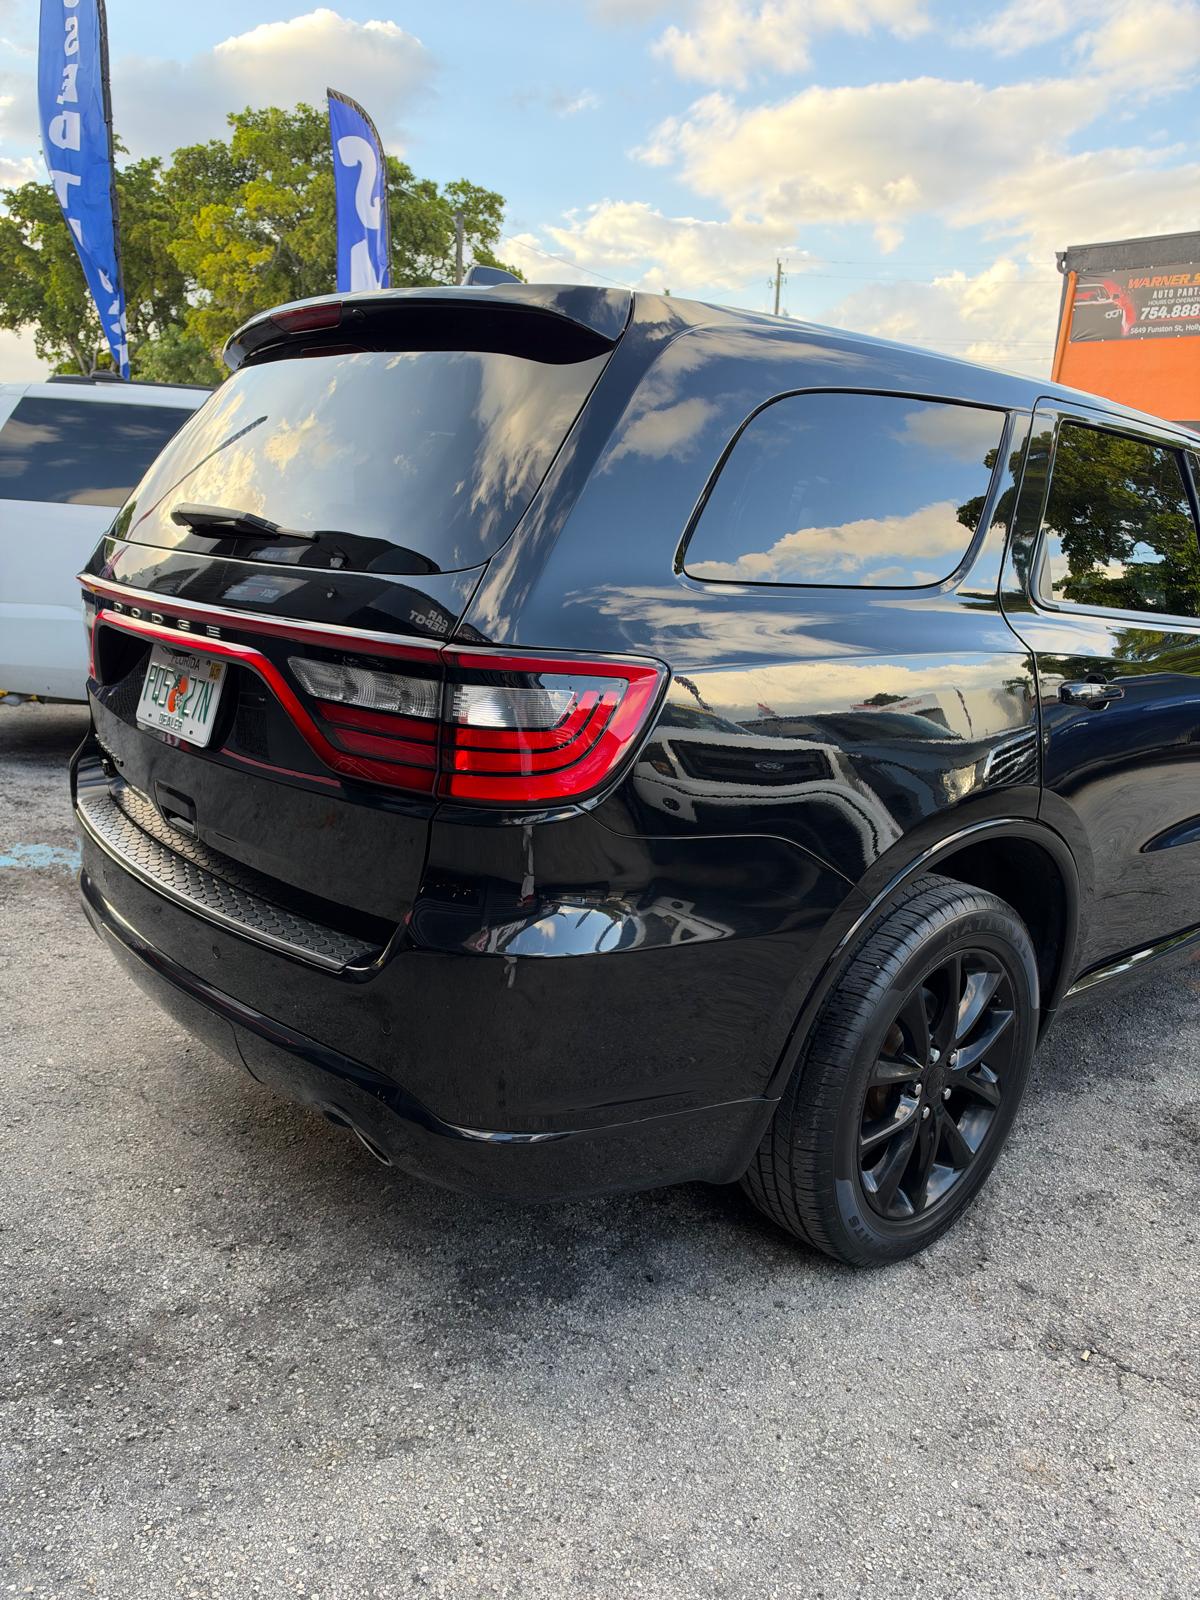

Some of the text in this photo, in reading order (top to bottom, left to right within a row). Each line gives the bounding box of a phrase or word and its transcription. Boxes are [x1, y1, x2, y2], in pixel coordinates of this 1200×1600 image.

[1128, 273, 1190, 289] WARNER
[1152, 287, 1200, 299] AUTO PART
[113, 602, 222, 638] DODGE
[170, 655, 201, 671] FLORIDA
[159, 711, 184, 731] DEALER
